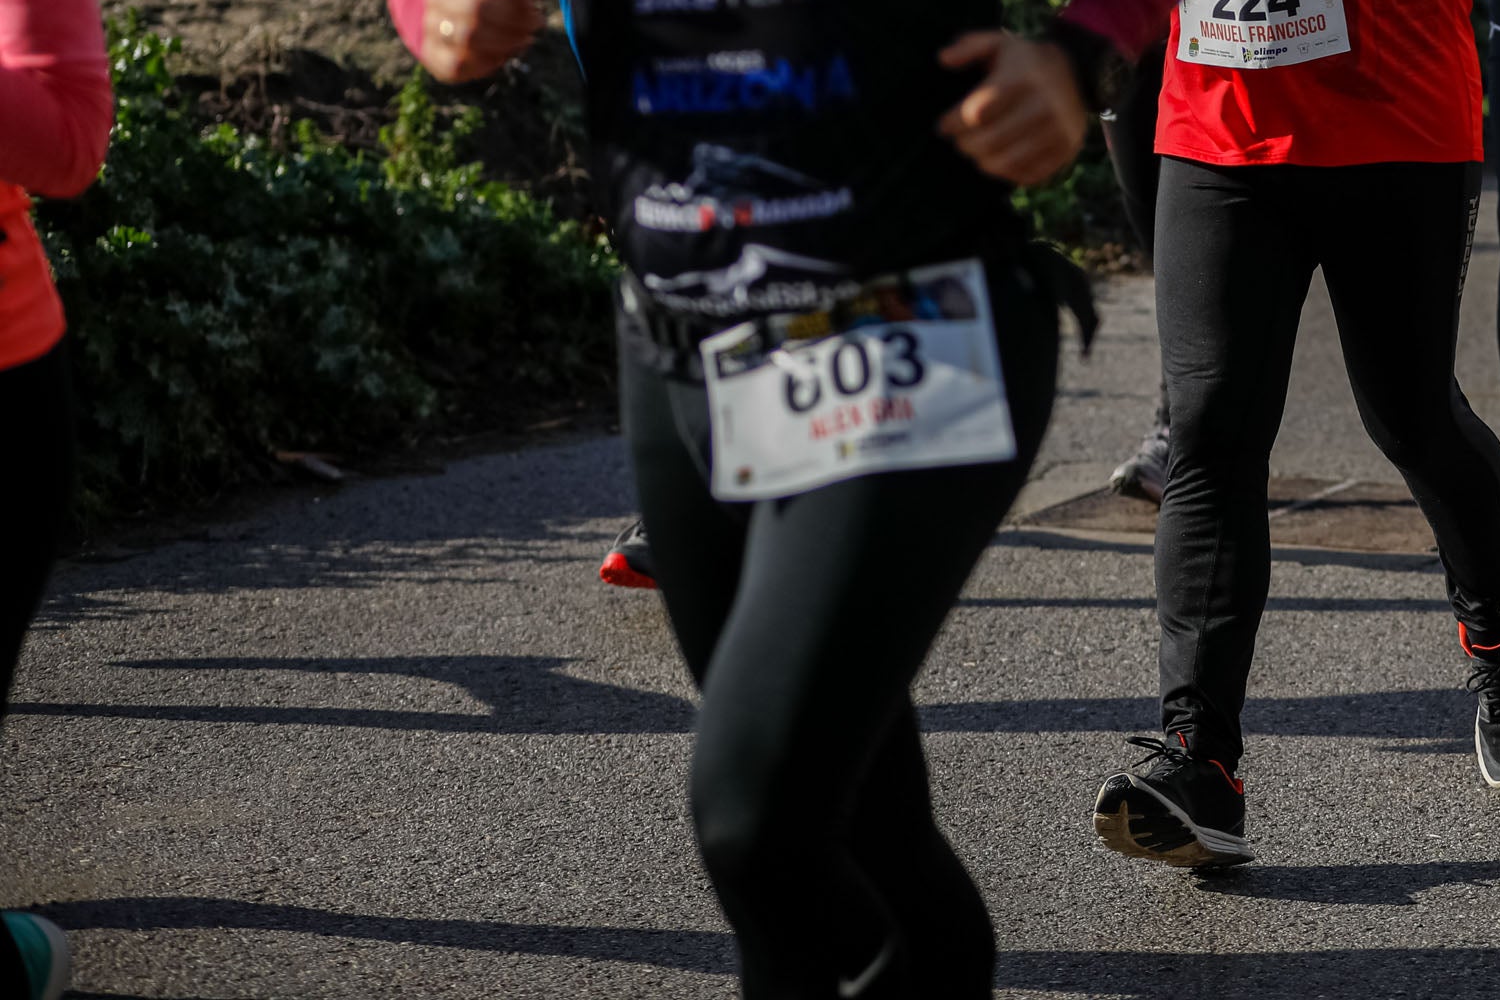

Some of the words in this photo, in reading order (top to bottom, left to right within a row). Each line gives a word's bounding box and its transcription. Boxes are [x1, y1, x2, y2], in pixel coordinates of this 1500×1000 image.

[1200, 21, 1246, 43] MANUEL
[1249, 14, 1326, 43] FRANCISCO
[1254, 46, 1288, 56] olimpo
